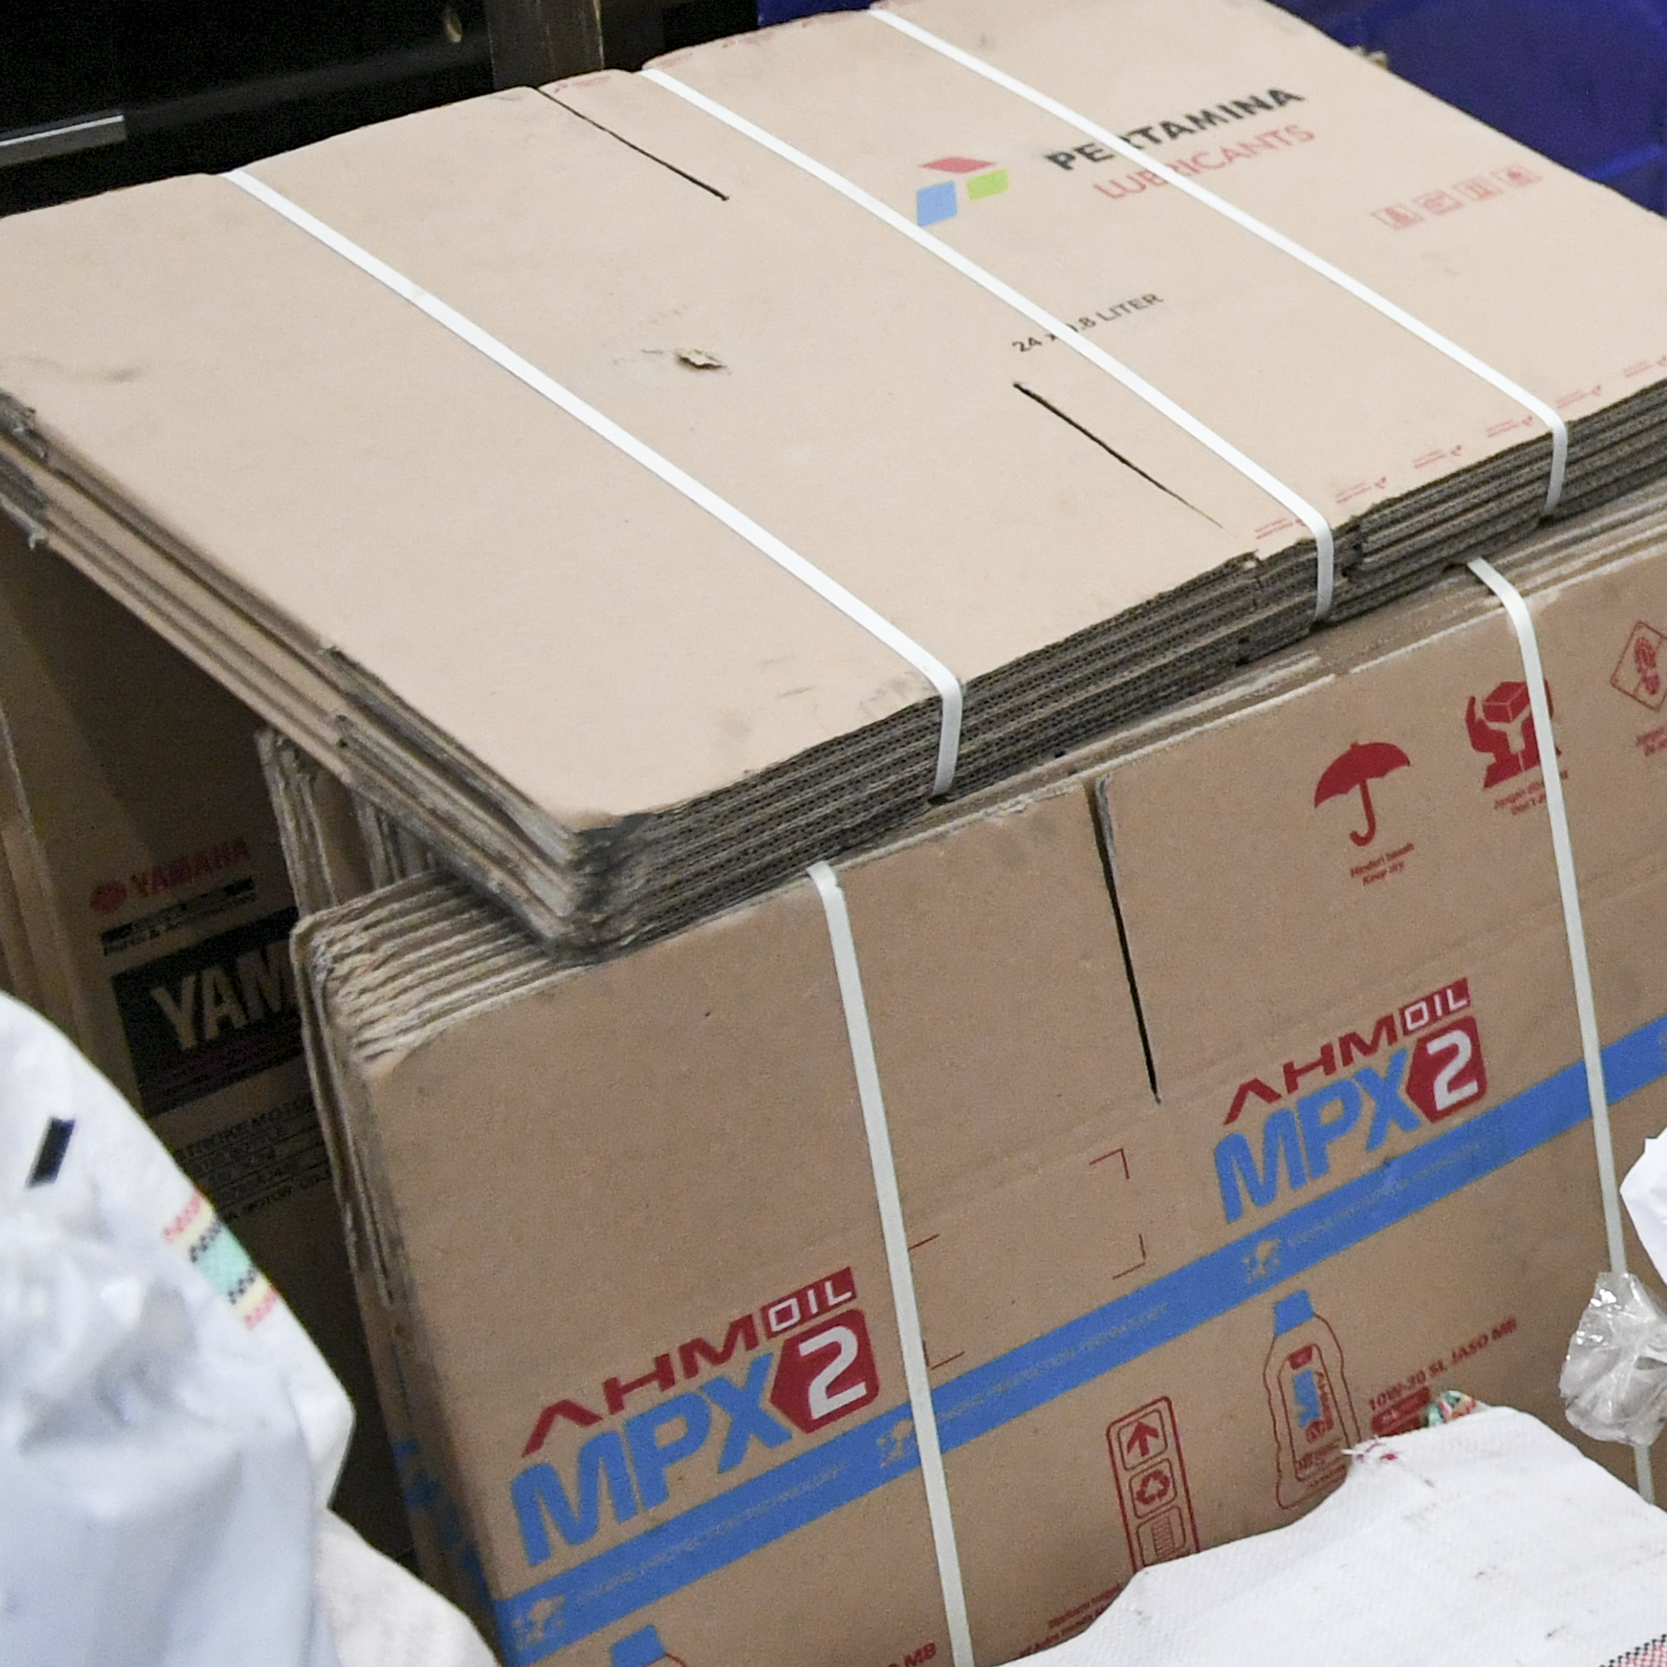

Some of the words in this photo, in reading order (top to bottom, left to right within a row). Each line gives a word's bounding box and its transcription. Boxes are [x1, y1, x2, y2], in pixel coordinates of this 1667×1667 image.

[1012, 337, 1042, 352] 24
[1096, 293, 1164, 322] LITER
[131, 837, 250, 897] YAMAHA
